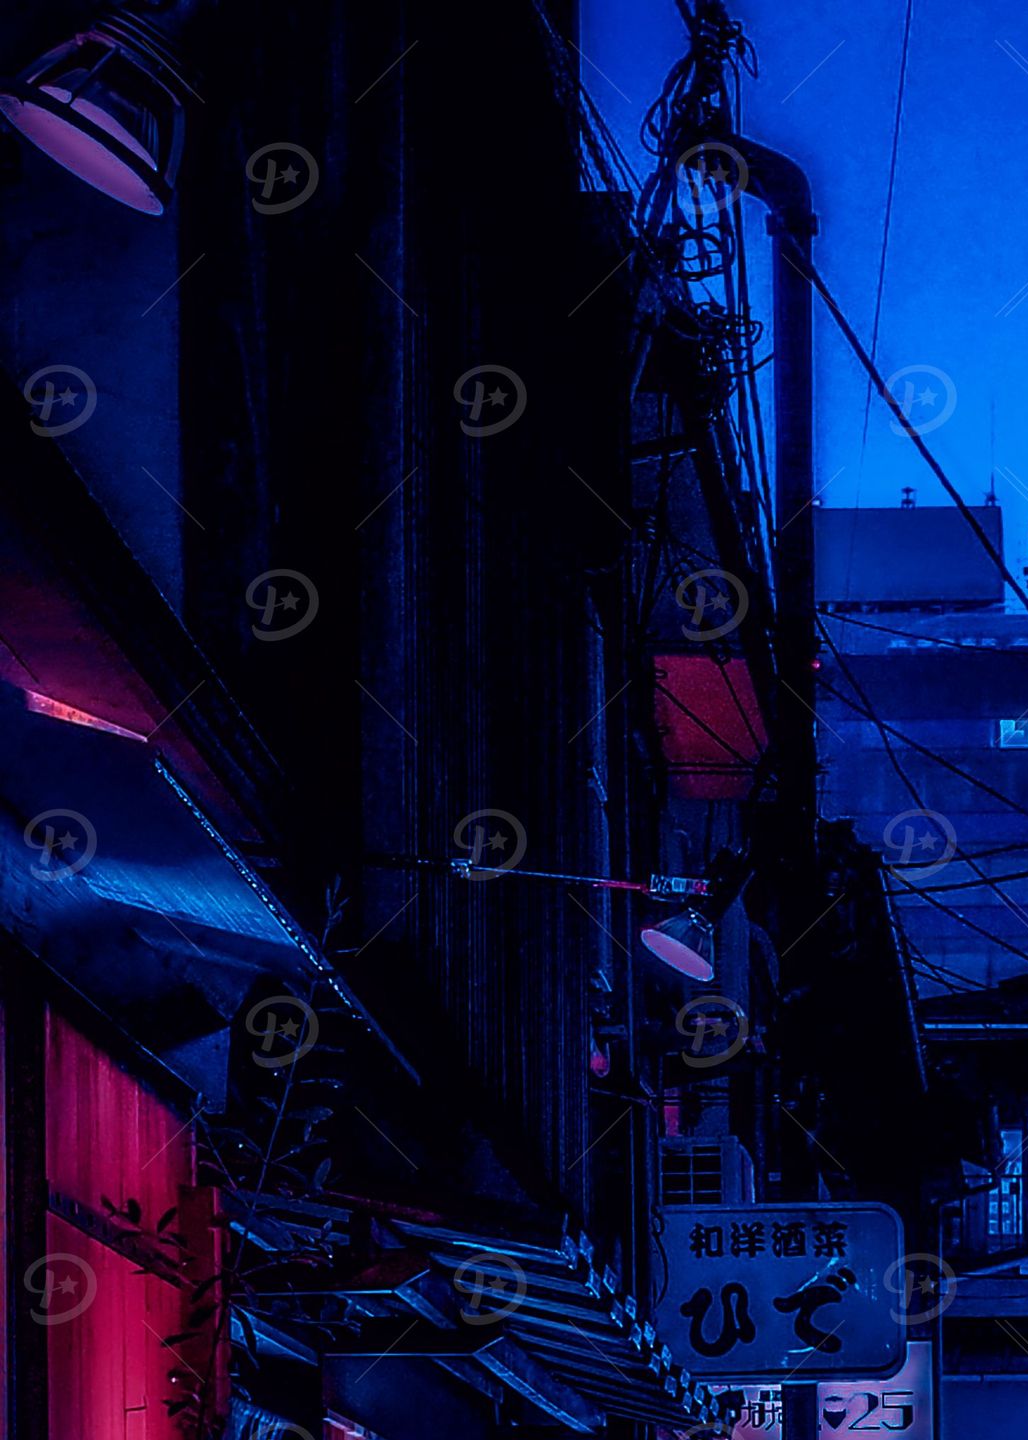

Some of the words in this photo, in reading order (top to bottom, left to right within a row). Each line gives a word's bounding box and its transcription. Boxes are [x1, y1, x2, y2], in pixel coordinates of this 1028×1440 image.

[689, 1222, 848, 1258] 和洋酒菜
[680, 1267, 856, 1358] ひで
